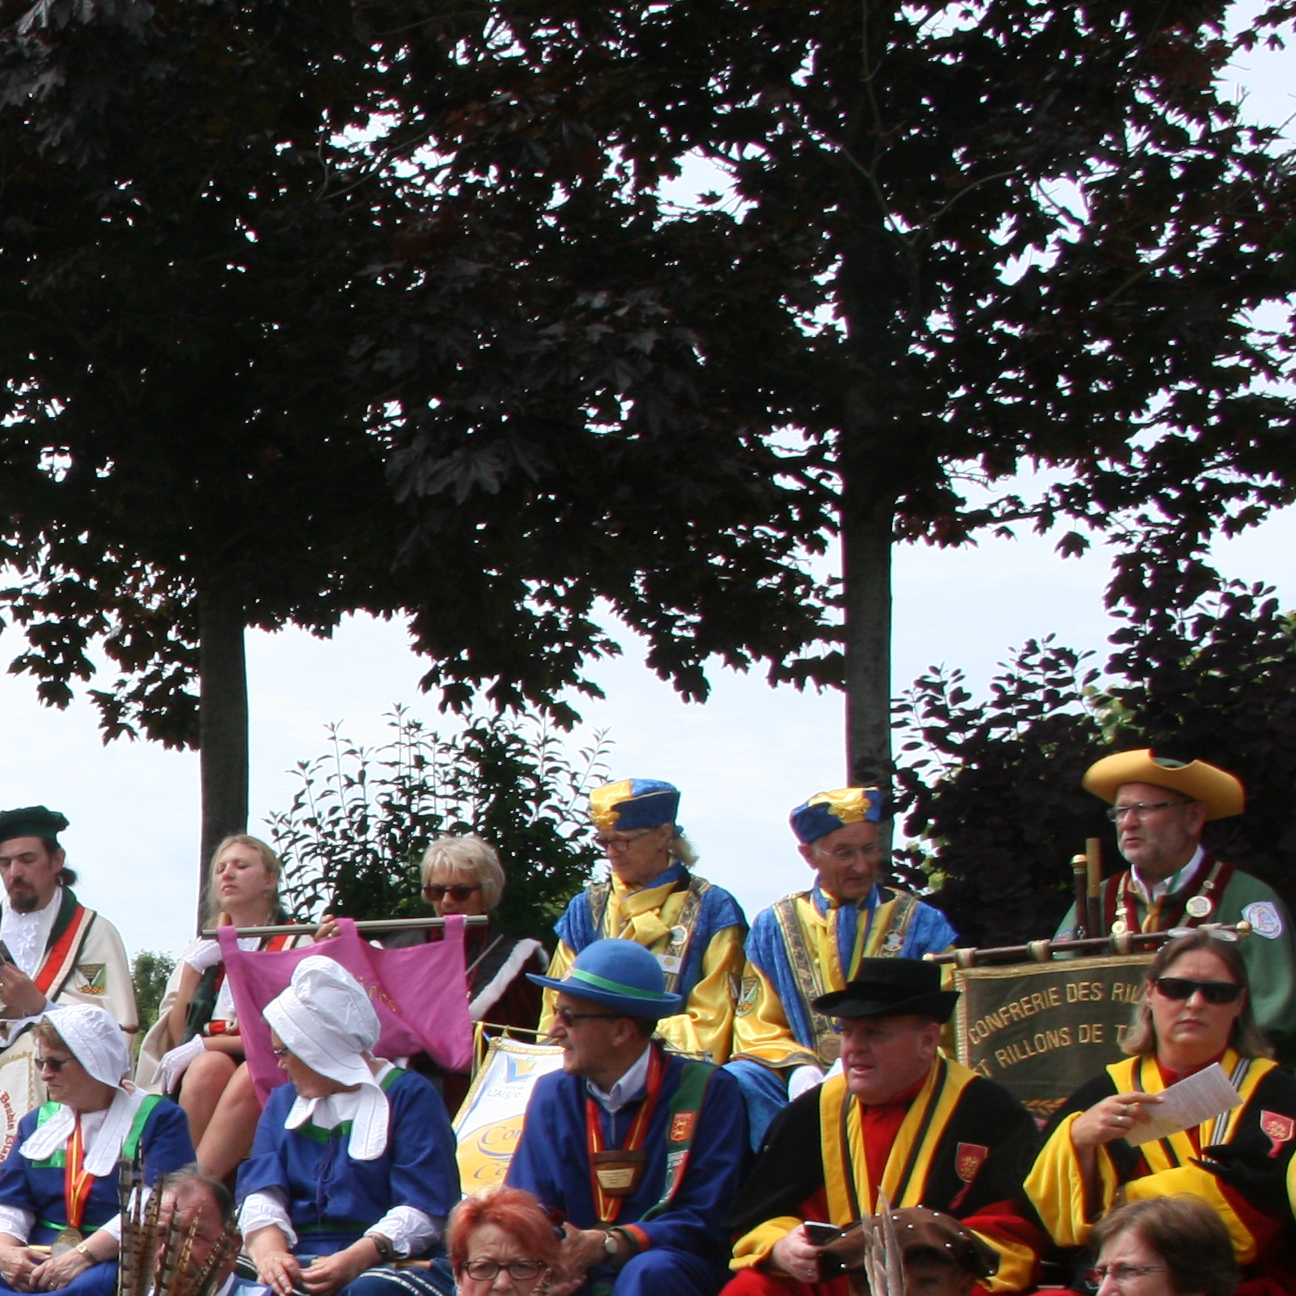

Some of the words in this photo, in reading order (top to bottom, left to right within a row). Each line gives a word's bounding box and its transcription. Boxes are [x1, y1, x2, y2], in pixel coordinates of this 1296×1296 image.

[968, 986, 1063, 1045] CONFRERIE
[1066, 981, 1103, 1003] DES
[1111, 982, 1140, 1004] RIL
[994, 1026, 1073, 1069] RILLONS
[1078, 1023, 1104, 1044] DE
[0, 1090, 17, 1130] Boudin
